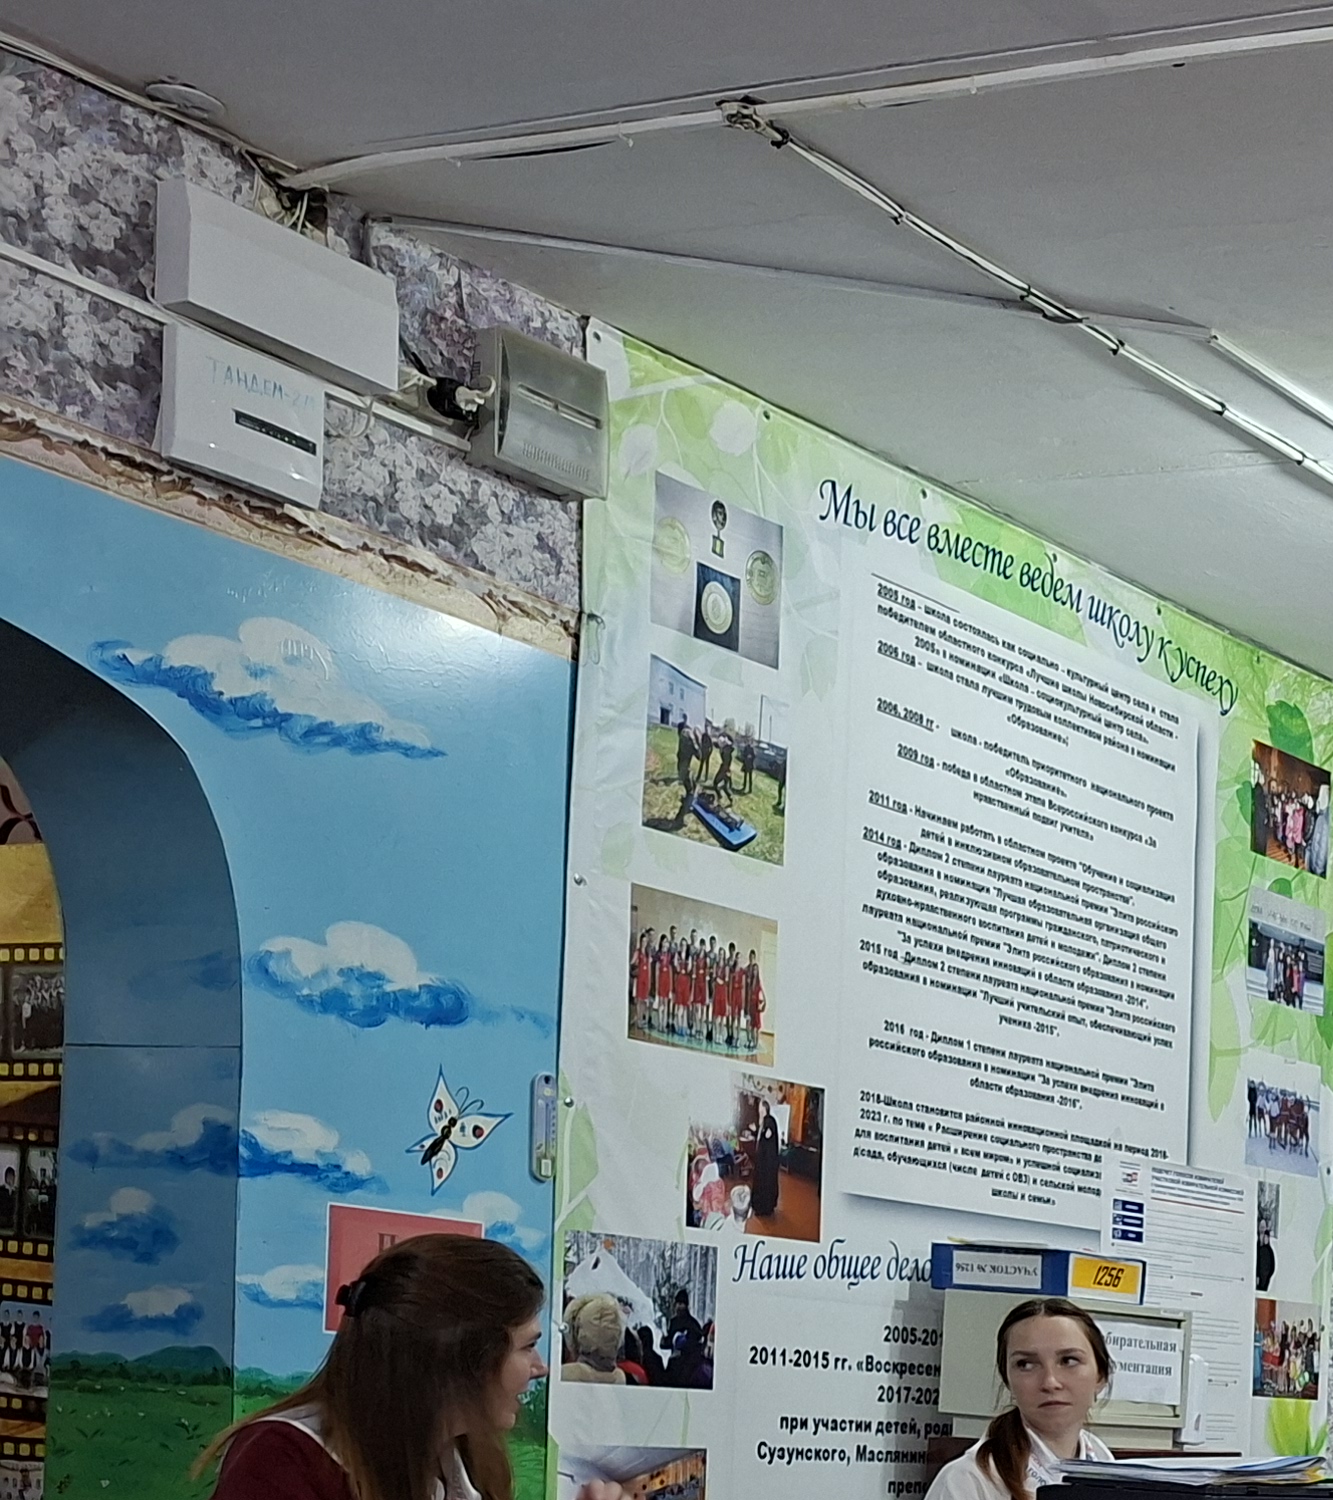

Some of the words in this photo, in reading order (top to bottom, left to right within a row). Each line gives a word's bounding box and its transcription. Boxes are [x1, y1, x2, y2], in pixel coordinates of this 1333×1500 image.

[818, 479, 877, 532] Мы
[883, 508, 921, 544] все
[927, 522, 1014, 581] вместе
[1019, 552, 1083, 611] ведем
[1087, 598, 1155, 663] школу
[1158, 636, 1173, 680] к
[1169, 646, 1239, 716] успеху
[876, 582, 899, 605] 2005
[877, 639, 900, 661] 2006
[868, 789, 890, 809] 2011
[862, 825, 885, 845] 2014
[859, 938, 882, 955] 2015
[859, 1107, 882, 1123] 2023
[732, 1240, 808, 1282] Наше
[813, 1238, 882, 1290] общее
[886, 1240, 932, 1282] дело
[955, 1262, 974, 1273] 1256
[990, 1264, 1038, 1276] УЧАСТОК
[1092, 1264, 1125, 1288] 1256
[883, 1325, 943, 1346] 2005-20
[749, 1346, 830, 1370] 2011-2015
[833, 1356, 852, 1371] гг.
[877, 1385, 939, 1405] 2017-202
[779, 1416, 808, 1436] при
[812, 1417, 872, 1436] участии
[875, 1418, 921, 1439] детей,
[757, 1441, 851, 1467] Сузунского,
